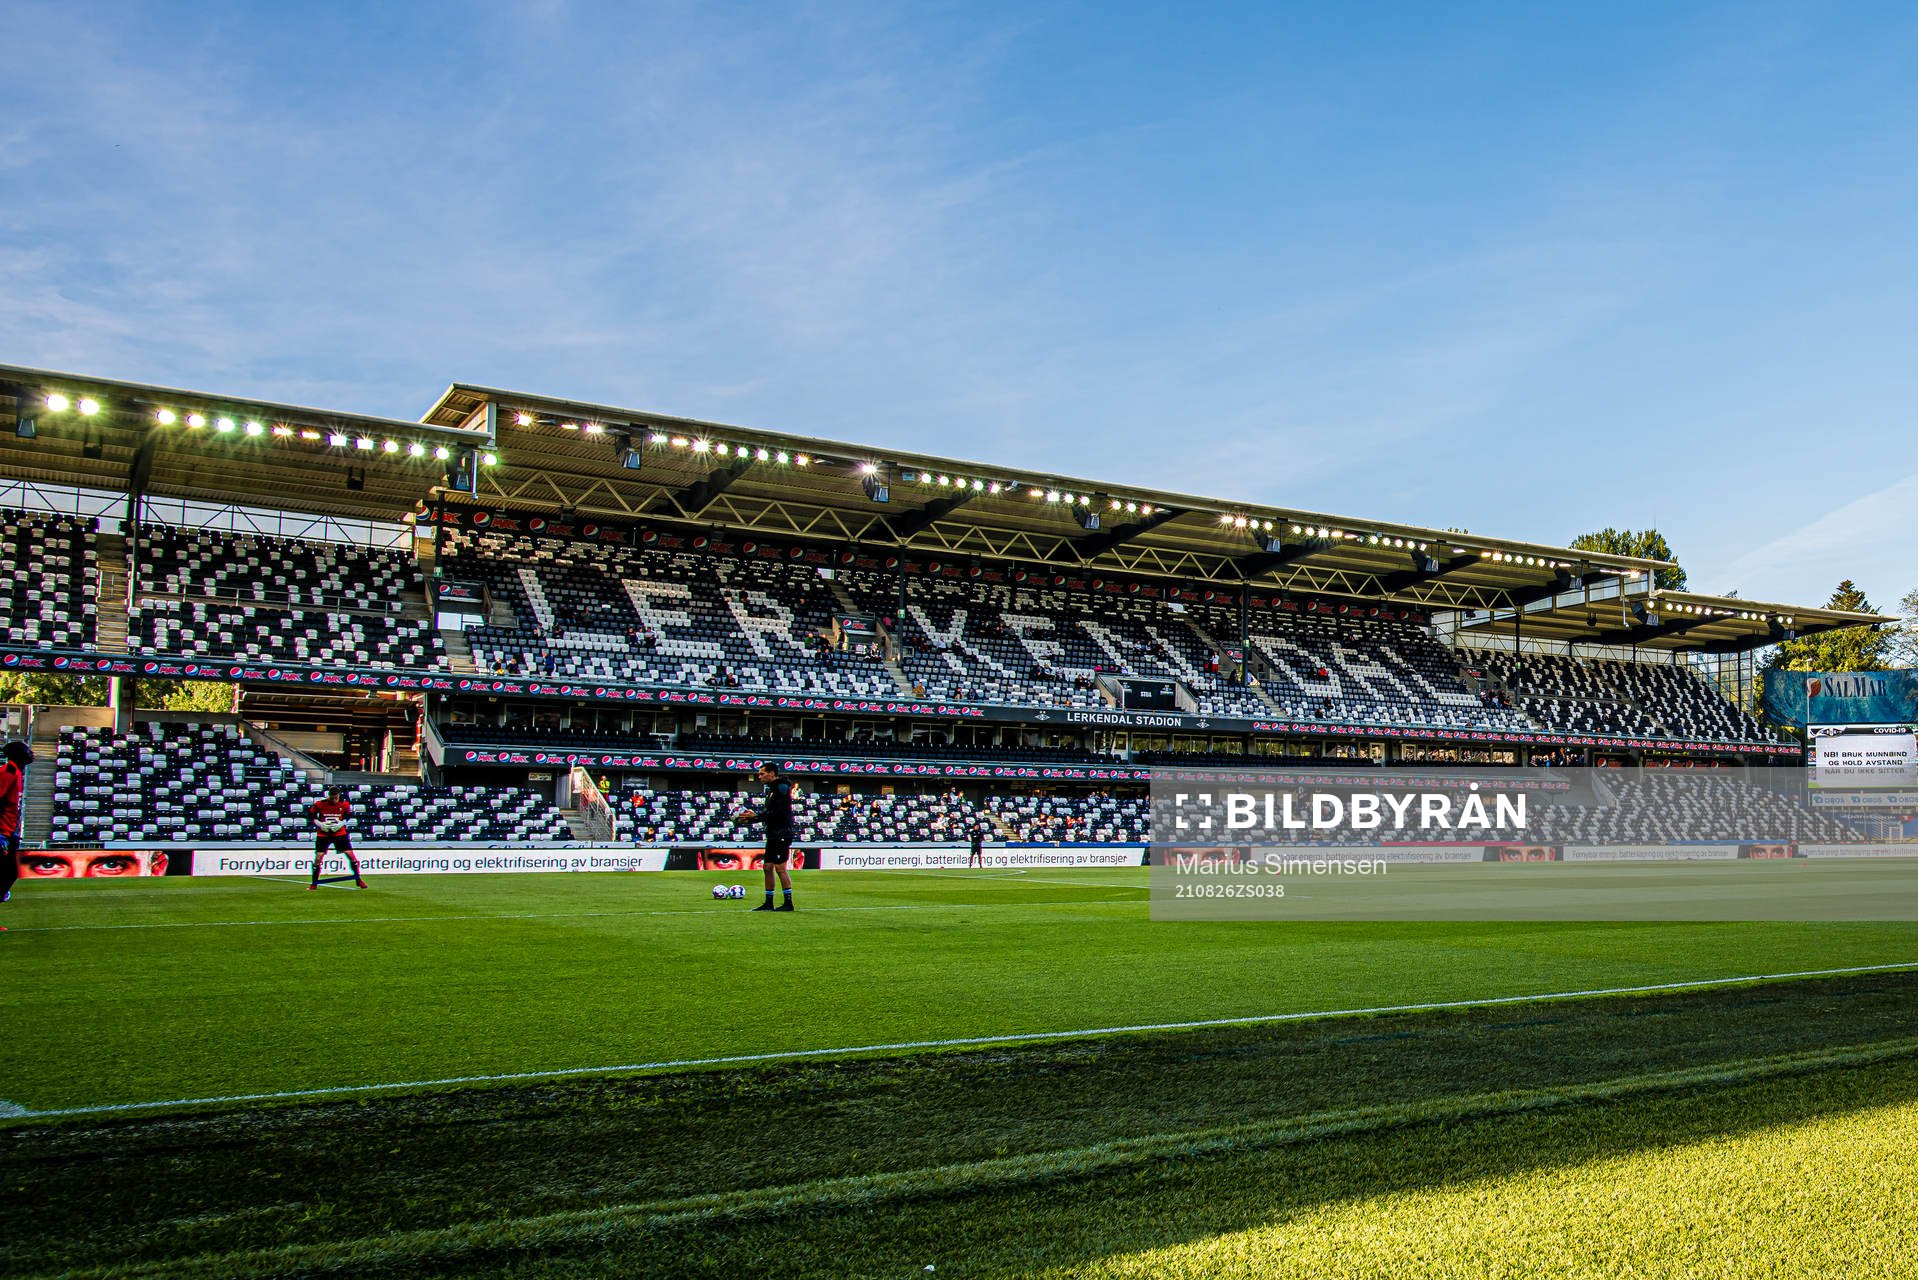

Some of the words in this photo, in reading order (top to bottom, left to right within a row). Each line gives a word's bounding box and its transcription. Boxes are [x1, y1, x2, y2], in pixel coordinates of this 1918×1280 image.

[1067, 712, 1133, 726] LERKENDAL
[1136, 715, 1182, 727] STADION
[838, 855, 886, 867] Fornybar
[888, 855, 923, 866] energi,
[995, 855, 1008, 865] og
[1010, 854, 1074, 864] elektrifisering
[1090, 854, 1127, 864] bransjer
[1387, 851, 1433, 861] elektrifisering
[1444, 851, 1472, 860] bransjer
[220, 858, 290, 872] Fornybar
[453, 859, 471, 870] og
[476, 855, 567, 869] elektrifisering
[571, 858, 587, 868] av
[590, 855, 643, 869] bransjer
